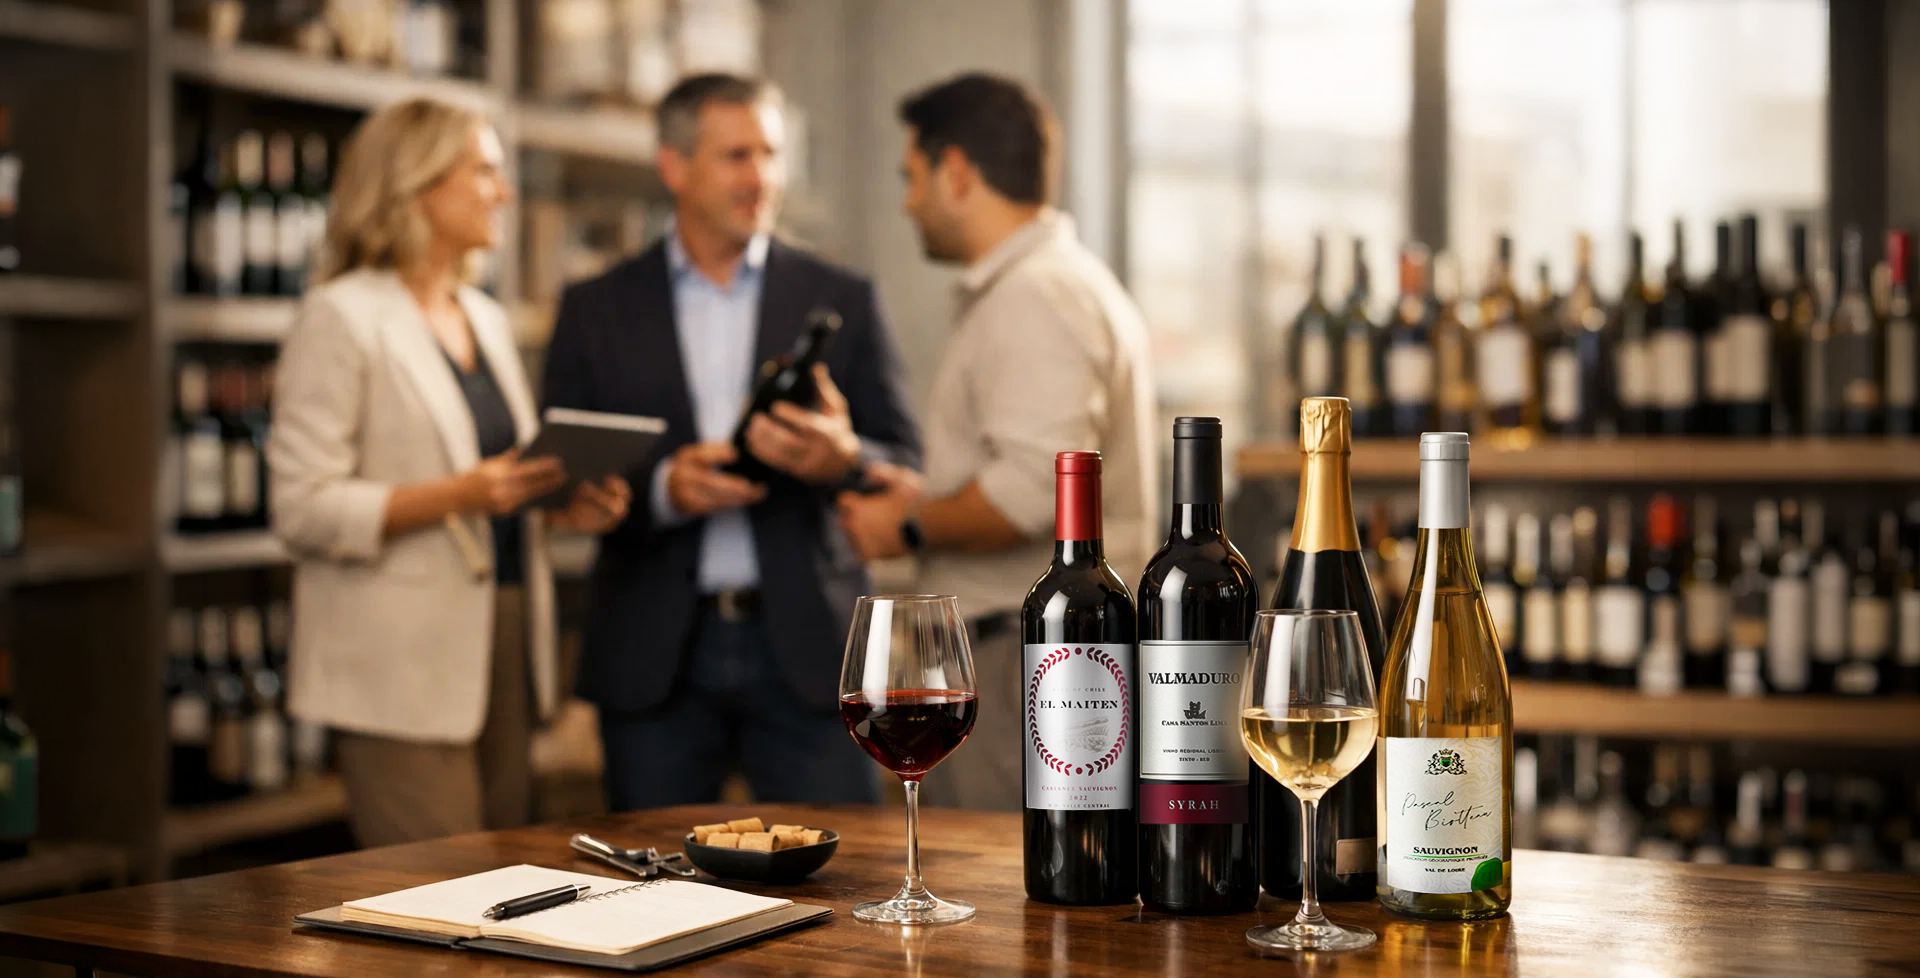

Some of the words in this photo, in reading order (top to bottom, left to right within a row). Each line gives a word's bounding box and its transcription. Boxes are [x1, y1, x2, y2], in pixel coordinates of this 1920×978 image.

[1147, 672, 1240, 685] VALMADURO
[1040, 700, 1056, 709] EL
[1060, 700, 1118, 709] MAITEN
[1168, 799, 1219, 810] SYRAH
[1401, 790, 1455, 816] Pascal
[1412, 846, 1479, 855] SAUVIGNON
